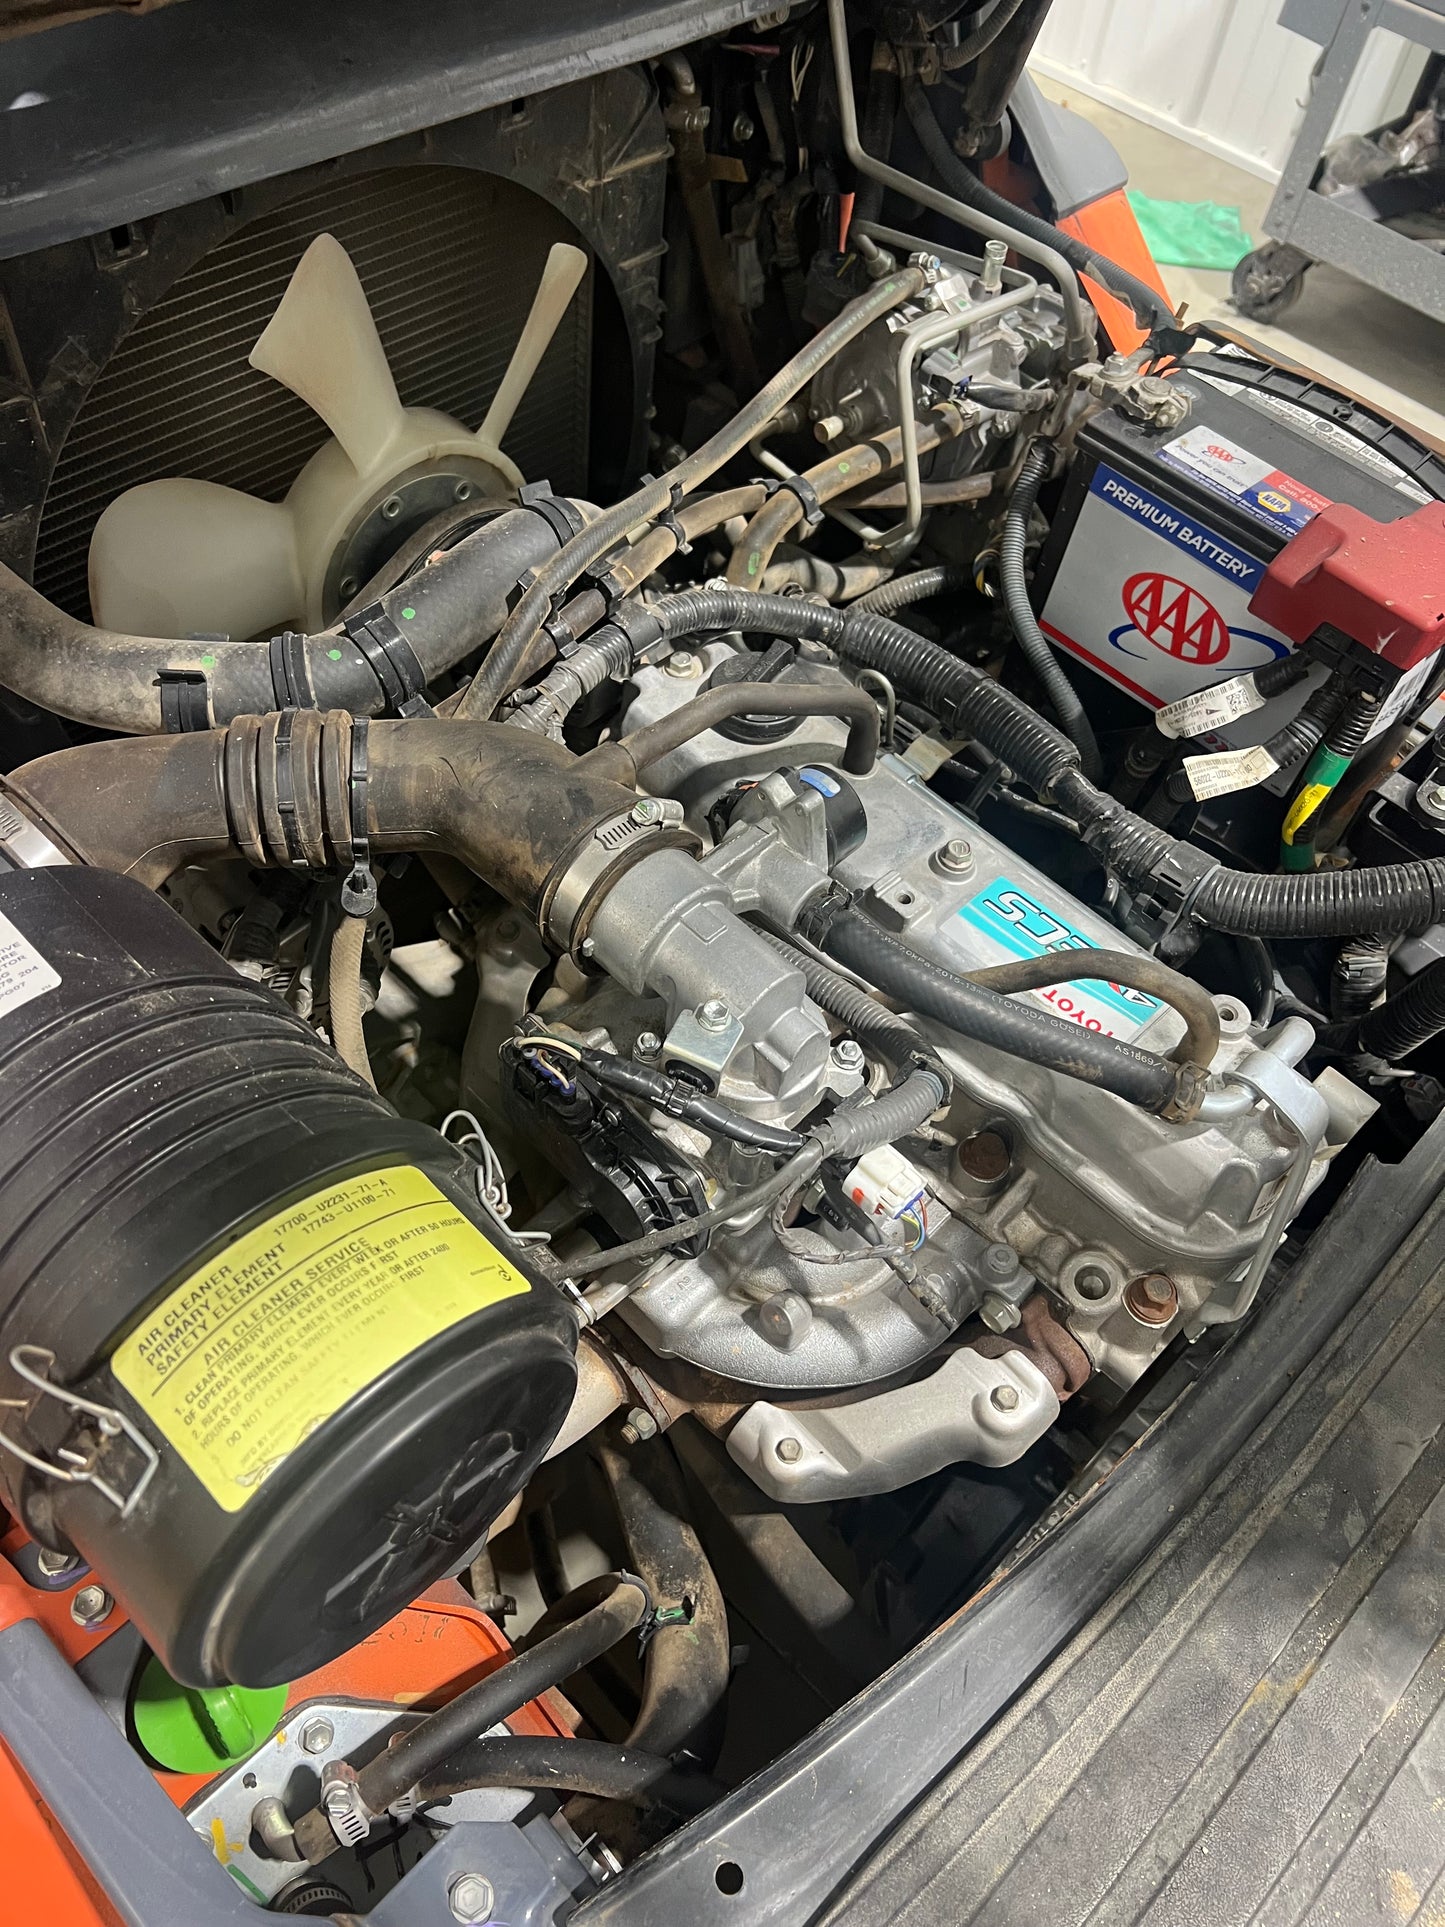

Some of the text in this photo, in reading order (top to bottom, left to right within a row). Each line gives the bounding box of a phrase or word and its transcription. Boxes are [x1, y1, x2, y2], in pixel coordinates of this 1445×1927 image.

[1176, 444, 1199, 460] Power
[1197, 458, 1213, 469] you
[1213, 468, 1225, 477] can
[1262, 492, 1286, 511] NAPA
[1103, 479, 1179, 533] PREMIUM
[1177, 527, 1255, 579] BATTERY
[1123, 573, 1229, 664] AAA
[0, 941, 22, 955] IVE
[0, 951, 19, 964] RE
[19, 966, 39, 978] 204
[991, 995, 1046, 1023] (TOYODA
[1036, 987, 1114, 1039] OYOT
[1114, 1044, 1168, 1073] AS1869/A
[274, 1179, 387, 1236] 17700-U2231-71-A
[302, 1188, 395, 1234] 17743-U1100-71
[137, 1266, 231, 1355] AIR CLEANER
[146, 1244, 286, 1365] PRIMARY ELEMENT
[155, 1261, 284, 1375] SAFETY ELEMENT
[184, 1370, 217, 1403] CLEAN
[217, 1326, 267, 1370] PRIMARY
[268, 1287, 314, 1326] ELEMENT
[320, 1262, 353, 1287] EVERY
[385, 1237, 399, 1248] OR
[402, 1225, 429, 1242] AFTER
[428, 1223, 440, 1231] 50
[440, 1217, 466, 1226] HOURS
[202, 1236, 368, 1364] AIR CLEANER SERVICE
[182, 1408, 199, 1425] OF
[258, 1318, 296, 1349] WHICH
[297, 1295, 327, 1318] EVER
[328, 1265, 369, 1297] OCCURS
